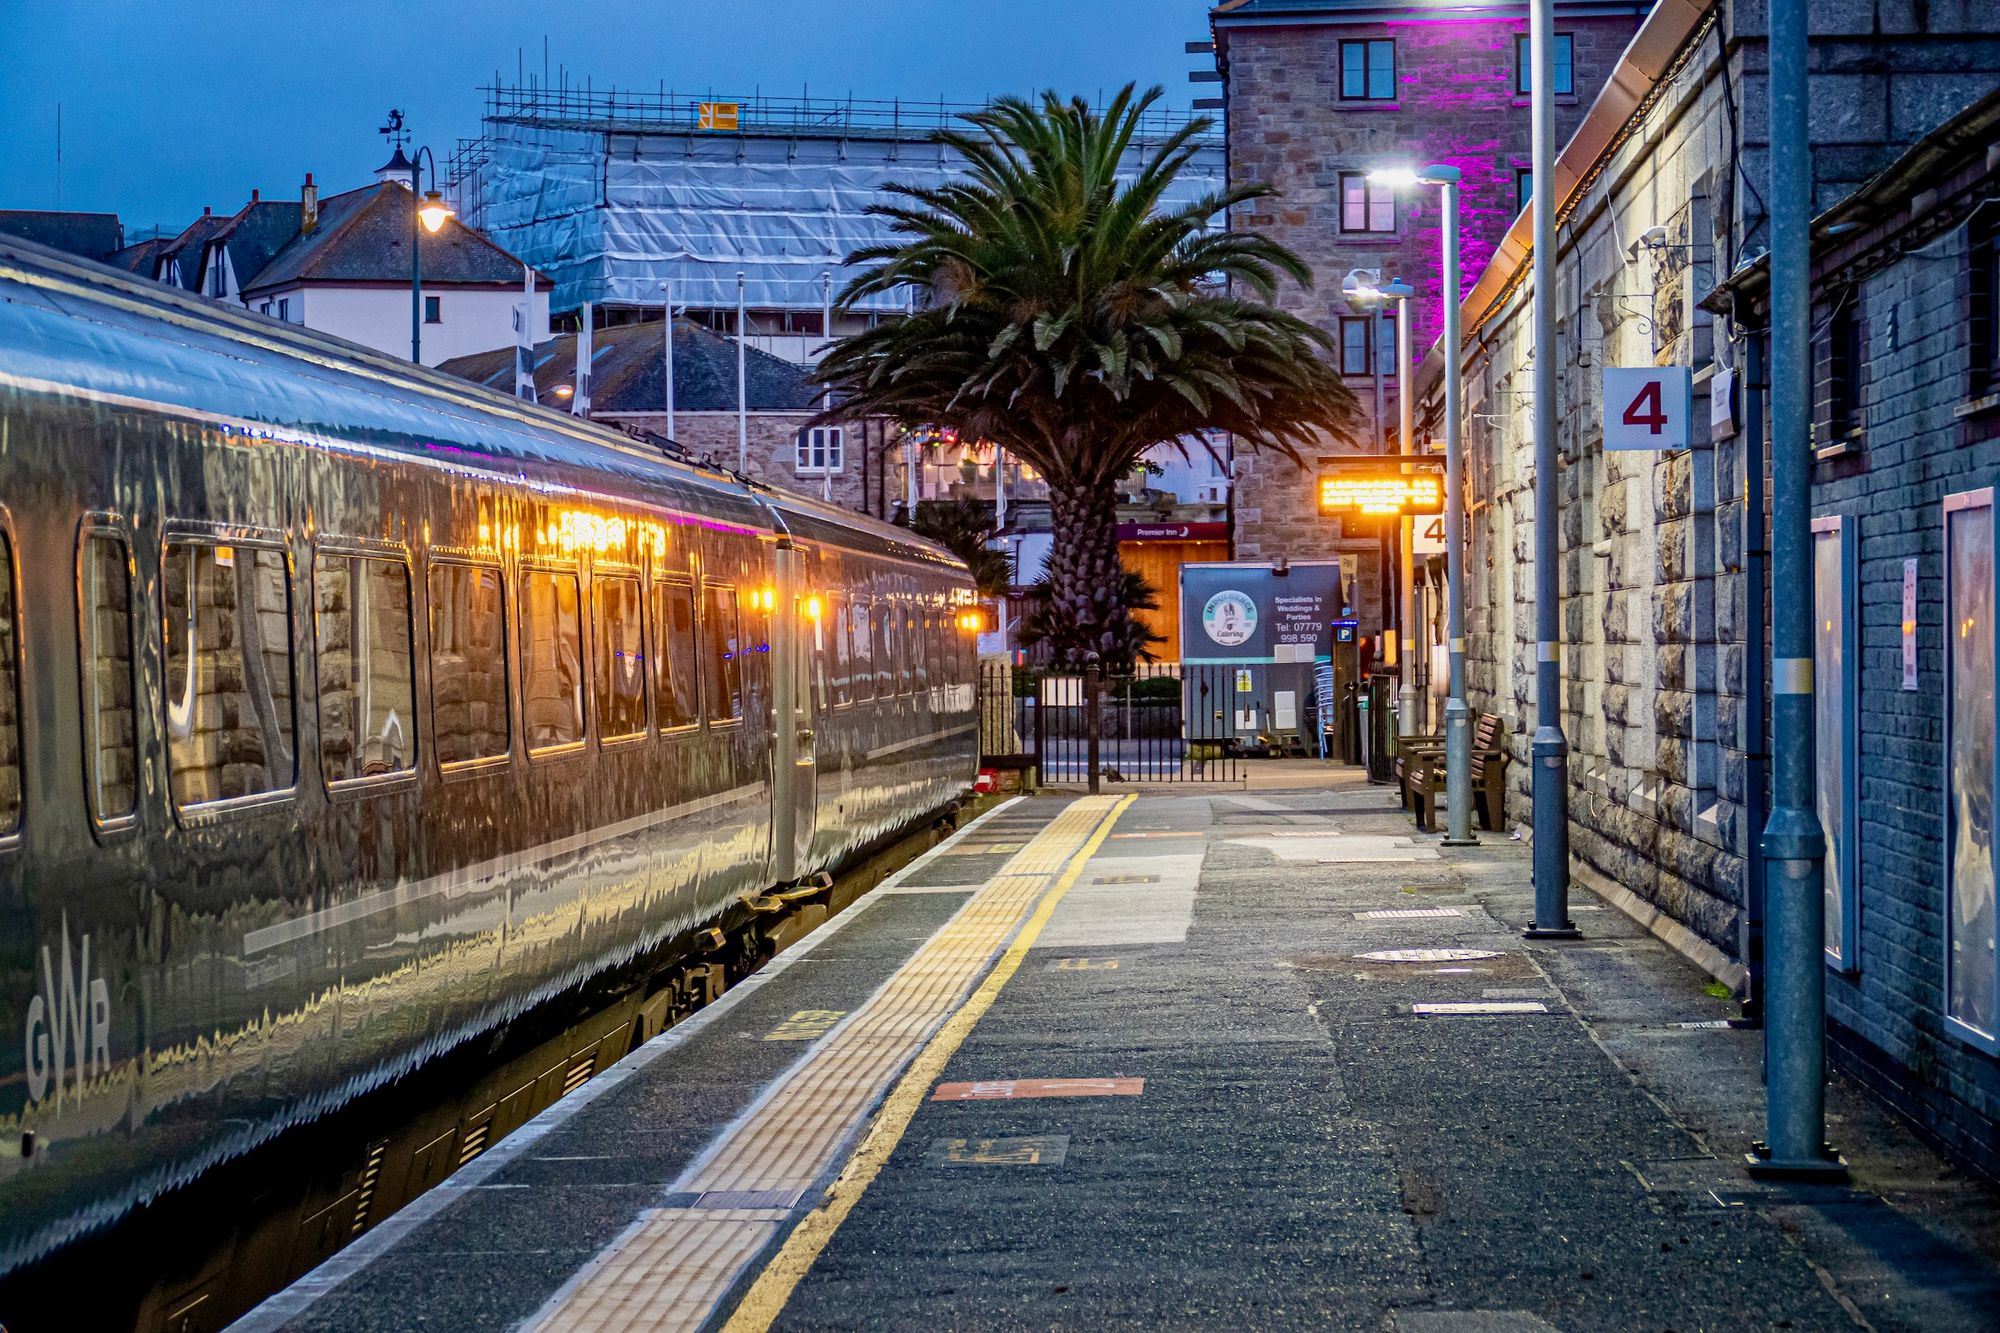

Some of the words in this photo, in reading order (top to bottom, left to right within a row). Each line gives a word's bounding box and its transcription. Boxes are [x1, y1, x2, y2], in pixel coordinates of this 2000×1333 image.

[1622, 381, 1668, 435] 4
[1137, 528, 1165, 536] Premier
[1166, 528, 1178, 536] Inn
[1423, 518, 1446, 544] 4
[1274, 596, 1314, 604] Specialists
[1277, 605, 1313, 613] Weddings
[1275, 622, 1291, 632] Tel:
[1293, 622, 1322, 632] 07779
[1217, 630, 1244, 639] Catering
[1280, 633, 1298, 643] 998
[1300, 633, 1318, 643] 590
[1341, 629, 1350, 639] P
[25, 906, 110, 1120] GWR
